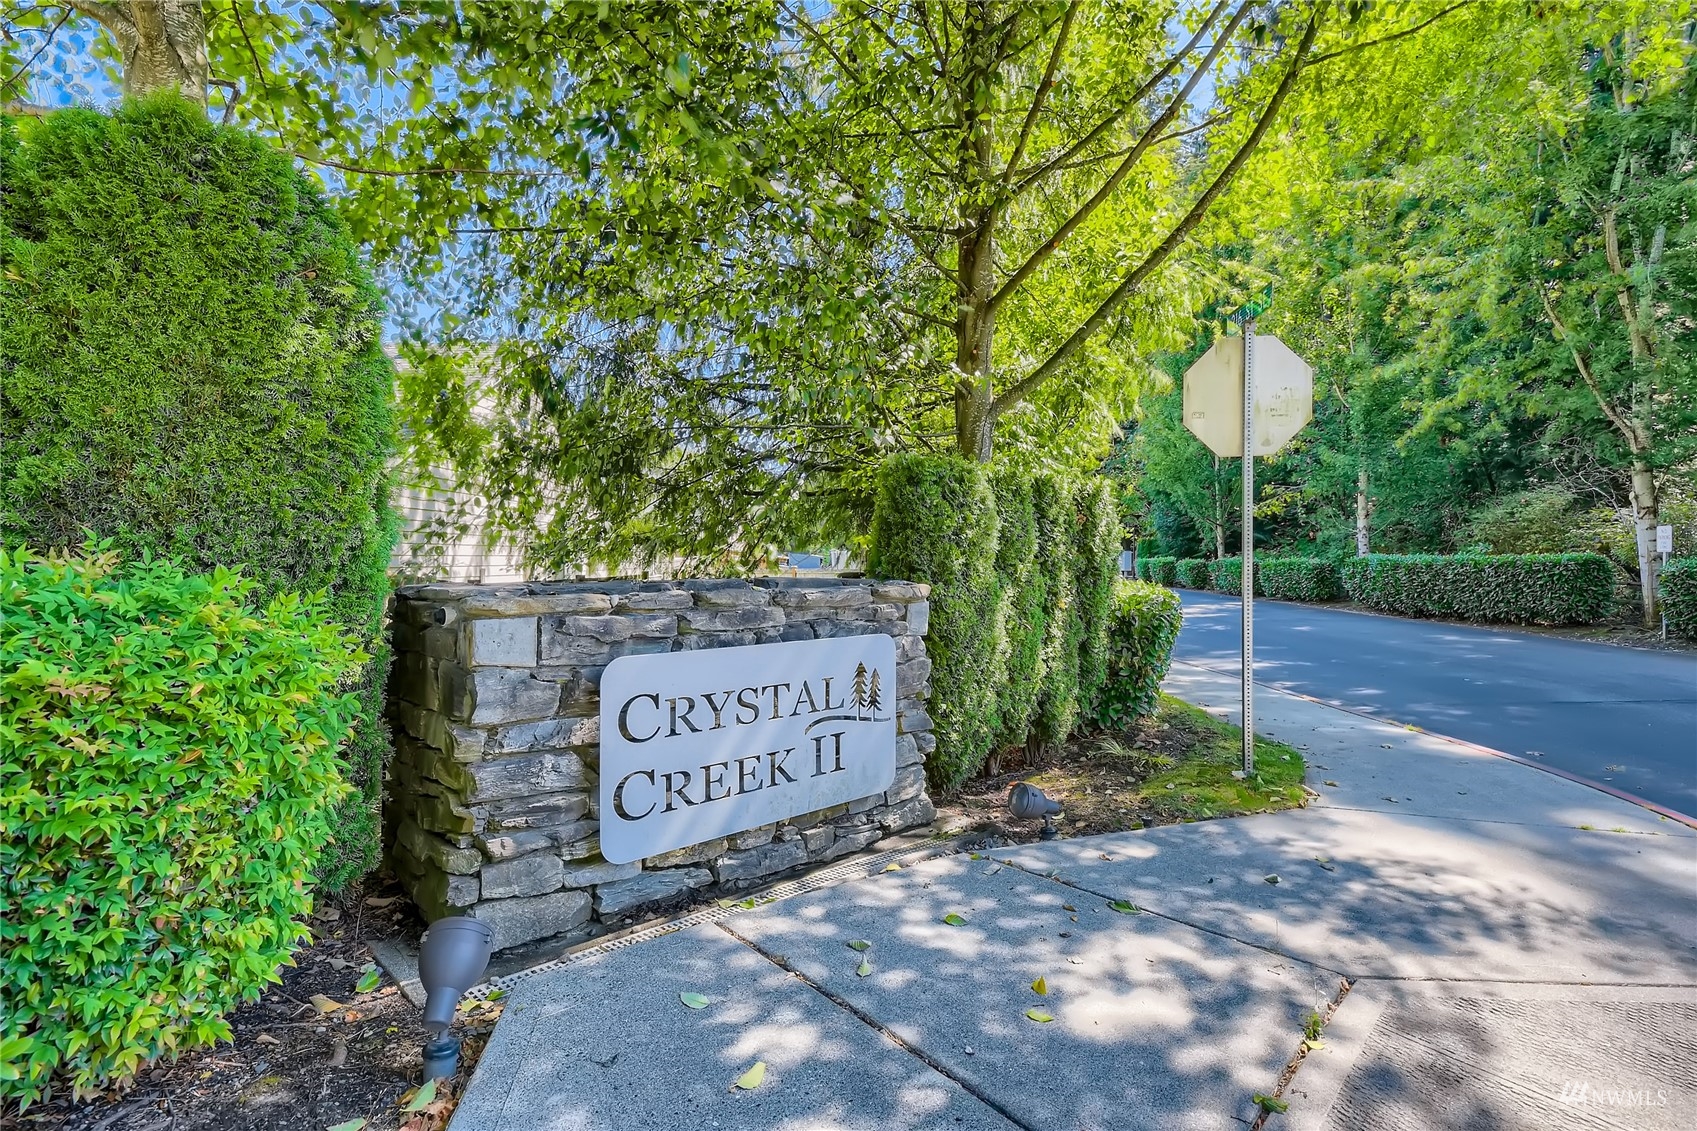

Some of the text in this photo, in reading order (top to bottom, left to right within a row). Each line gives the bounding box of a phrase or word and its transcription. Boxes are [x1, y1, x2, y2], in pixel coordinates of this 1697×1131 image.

[617, 677, 845, 744] CRYSTAL
[612, 731, 846, 821] CREEK II
